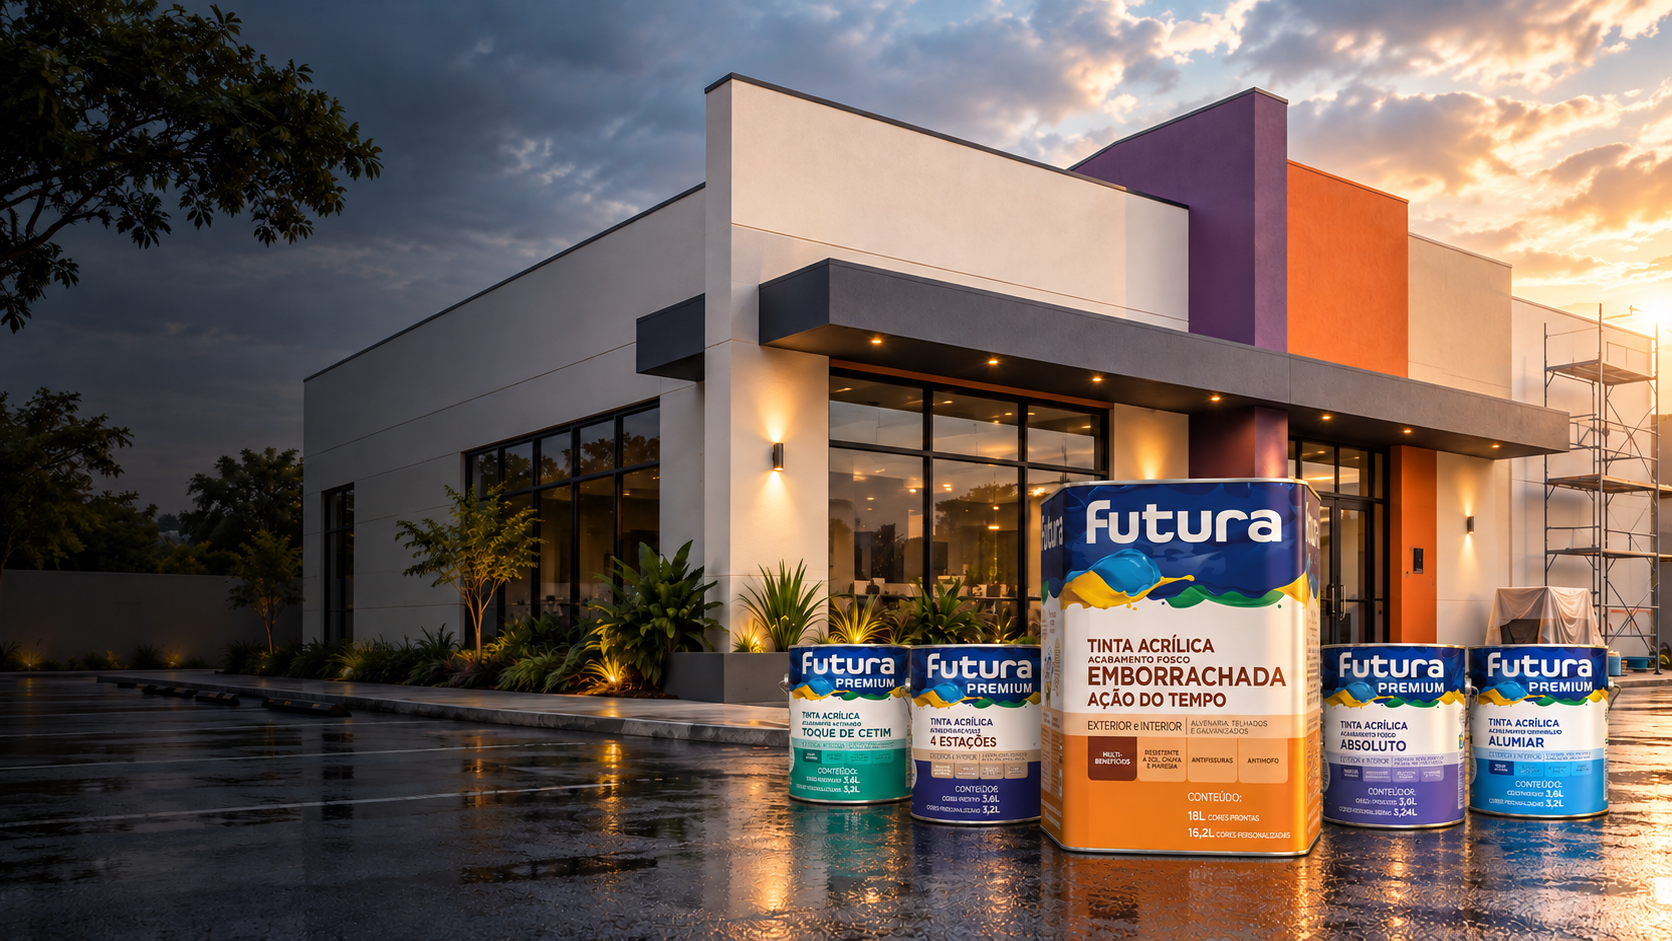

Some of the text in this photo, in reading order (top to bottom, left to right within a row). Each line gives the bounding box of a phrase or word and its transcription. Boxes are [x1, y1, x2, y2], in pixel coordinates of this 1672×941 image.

[1087, 634, 1215, 653] TINTA ACRÍLICA
[1088, 655, 1191, 664] ACABAMENTO FOSCO
[1087, 666, 1287, 687] EMBORRACHADA
[836, 678, 895, 688] PREMIUM
[966, 683, 1033, 694] PREMIUM
[1377, 682, 1444, 693] PREMIUM
[1528, 681, 1593, 692] PREMIUM
[1087, 688, 1227, 709] AÇÃO DO TEMPO
[822, 711, 861, 720] ACRÍLICA
[929, 716, 994, 726] TINTA ACRÍLICA
[1087, 720, 1183, 732] EXTERIOR e INTERIOR
[1340, 719, 1409, 730] TINTA ACRÍLICA
[1488, 717, 1560, 727] TINTA ACRÍLICA
[802, 727, 892, 739] TOQUE DE CETIM
[930, 734, 997, 750] 4 ESTAÇÕES
[1340, 739, 1407, 752] ABSOLUTO
[1488, 736, 1545, 748] ALUMIAR
[1247, 757, 1280, 765] ANTIMOFO
[1187, 790, 1243, 803] CONTEÚDO:
[1187, 810, 1206, 822] 18L
[1229, 814, 1261, 823] PRONTAS
[1188, 827, 1215, 840] 16,2L
